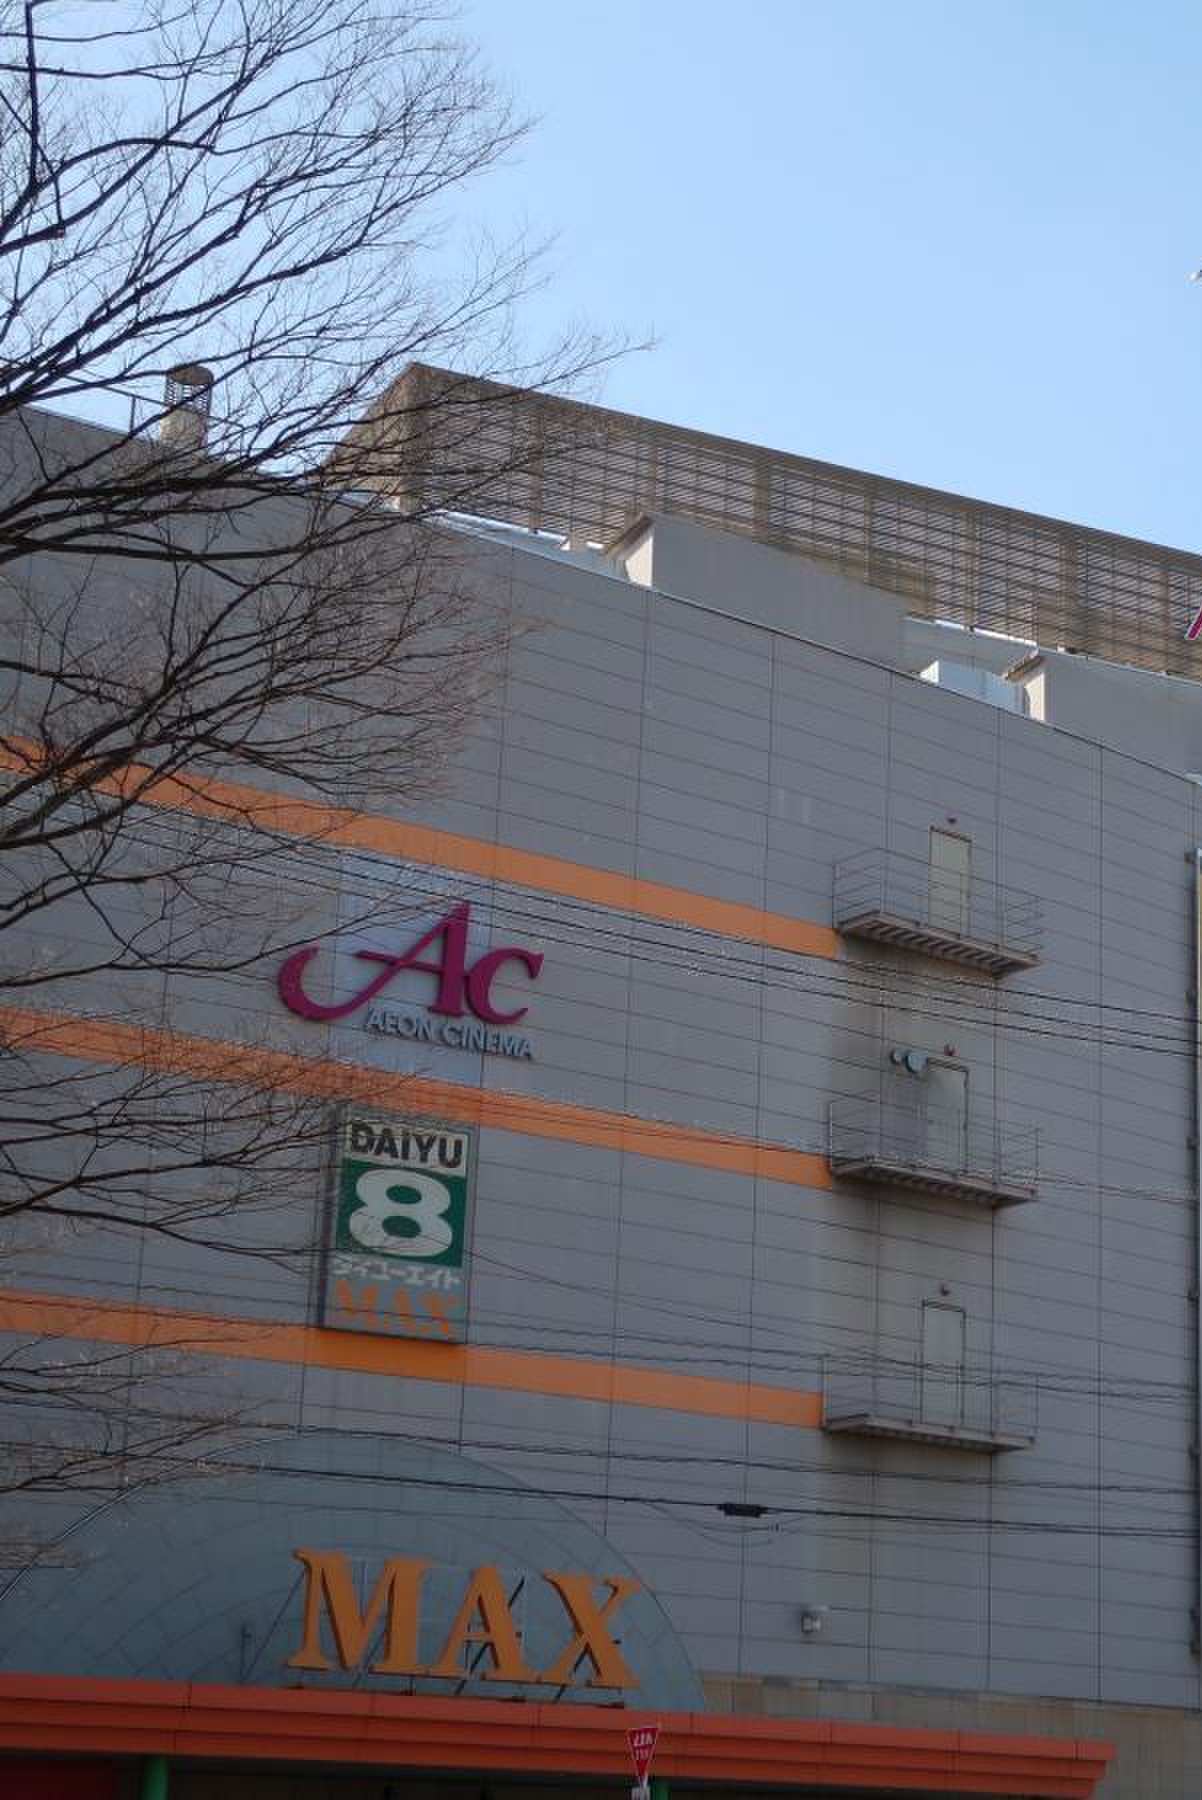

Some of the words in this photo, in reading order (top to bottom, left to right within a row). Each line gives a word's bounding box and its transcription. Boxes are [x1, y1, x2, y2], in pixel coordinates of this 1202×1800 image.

[367, 1007, 434, 1042] AEON
[441, 1023, 533, 1060] CINEMA
[351, 1124, 463, 1169] DAIYU
[350, 1168, 452, 1257] 8
[287, 1547, 642, 1690] MAX
